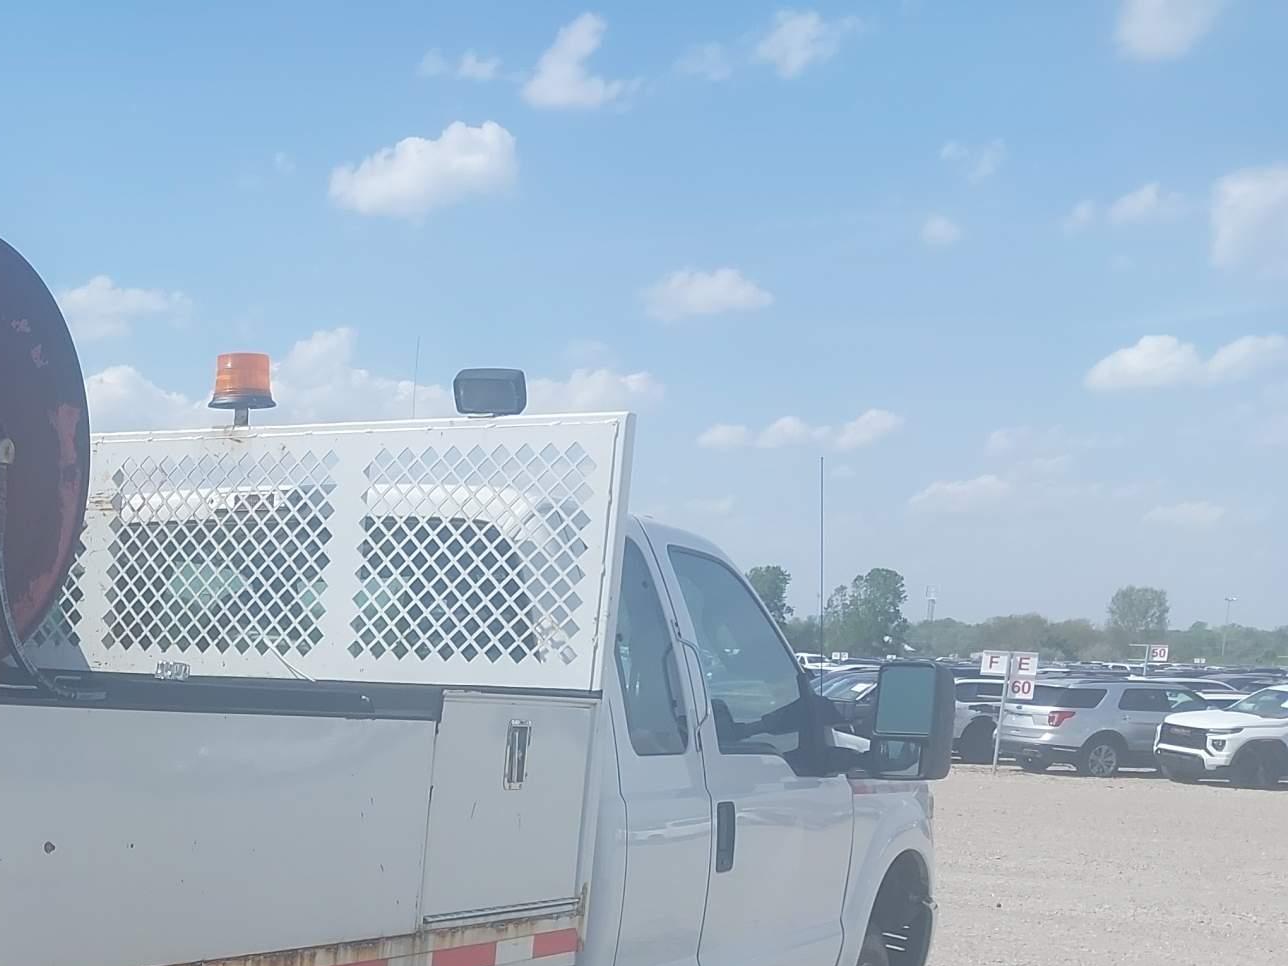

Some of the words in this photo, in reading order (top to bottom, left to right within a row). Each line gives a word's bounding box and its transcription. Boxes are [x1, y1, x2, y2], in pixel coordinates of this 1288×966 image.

[1152, 648, 1167, 658] 50
[989, 655, 1000, 670] F
[1018, 657, 1031, 670] E
[1011, 681, 1032, 695] 60
